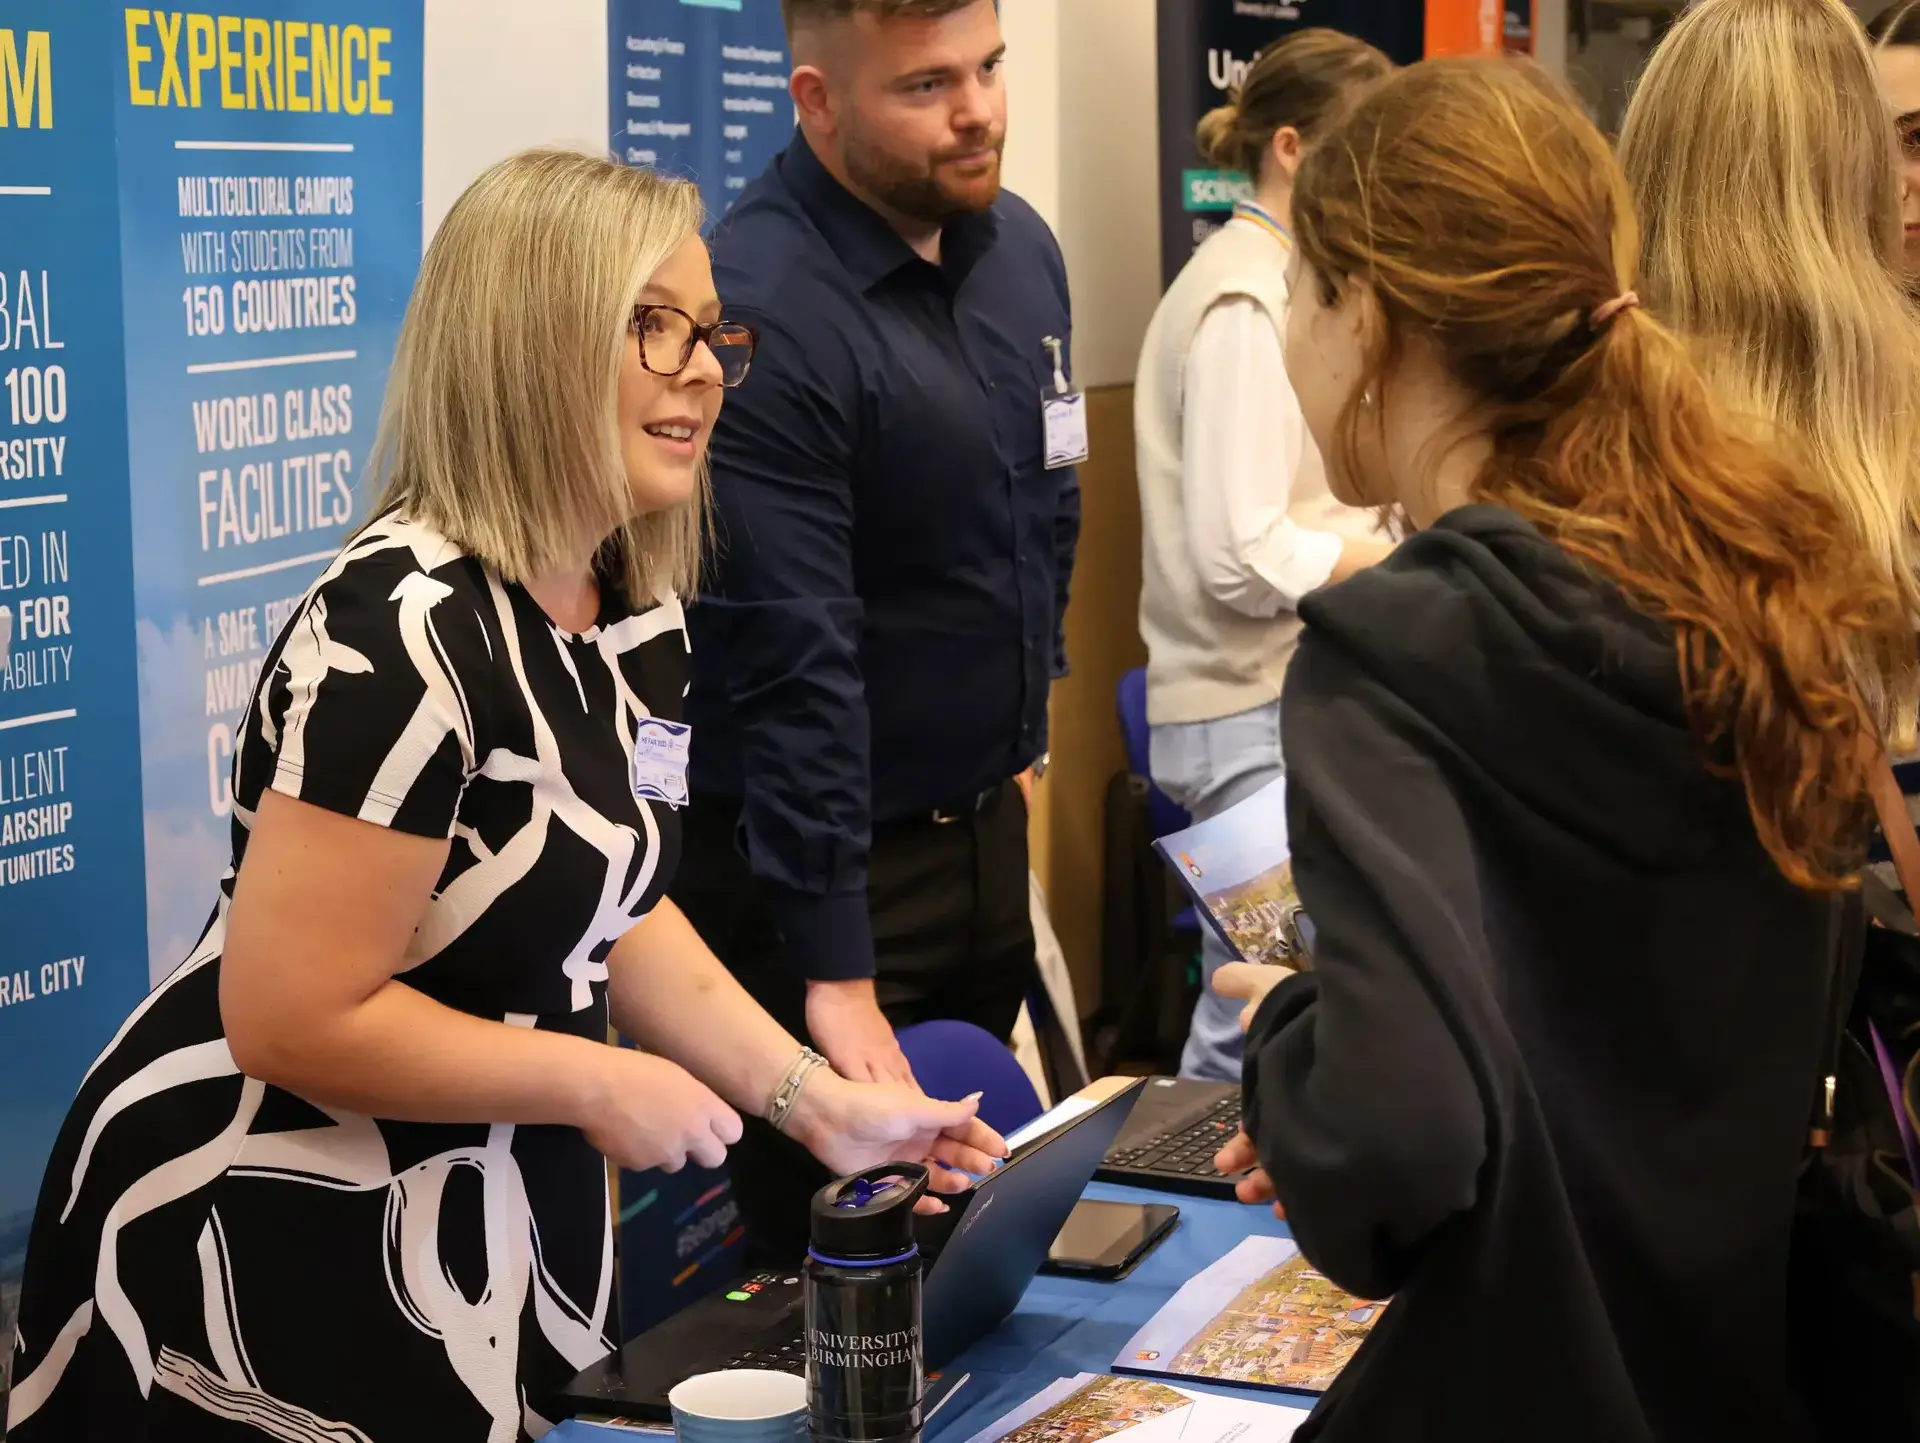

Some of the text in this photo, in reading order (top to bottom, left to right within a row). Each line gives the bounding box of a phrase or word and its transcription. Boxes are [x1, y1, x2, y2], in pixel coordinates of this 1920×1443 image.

[124, 8, 393, 116] EXPERIENCE
[177, 176, 354, 217] MULTICULTURAL CAMPUS
[181, 227, 354, 274] WITH STUDENTS FROM
[182, 274, 357, 337] 150 COUNTRIES
[5, 365, 67, 425] 100
[192, 384, 353, 453] WORLD CLASS
[198, 449, 353, 552] FACILITIES
[42, 530, 69, 584] IN
[19, 595, 72, 641] FOR
[204, 615, 215, 660] A
[218, 606, 262, 656] SAFE
[0, 802, 73, 847] ARSHIP
[40, 955, 85, 996] CITY
[811, 1328, 909, 1350] UNIVERSITY
